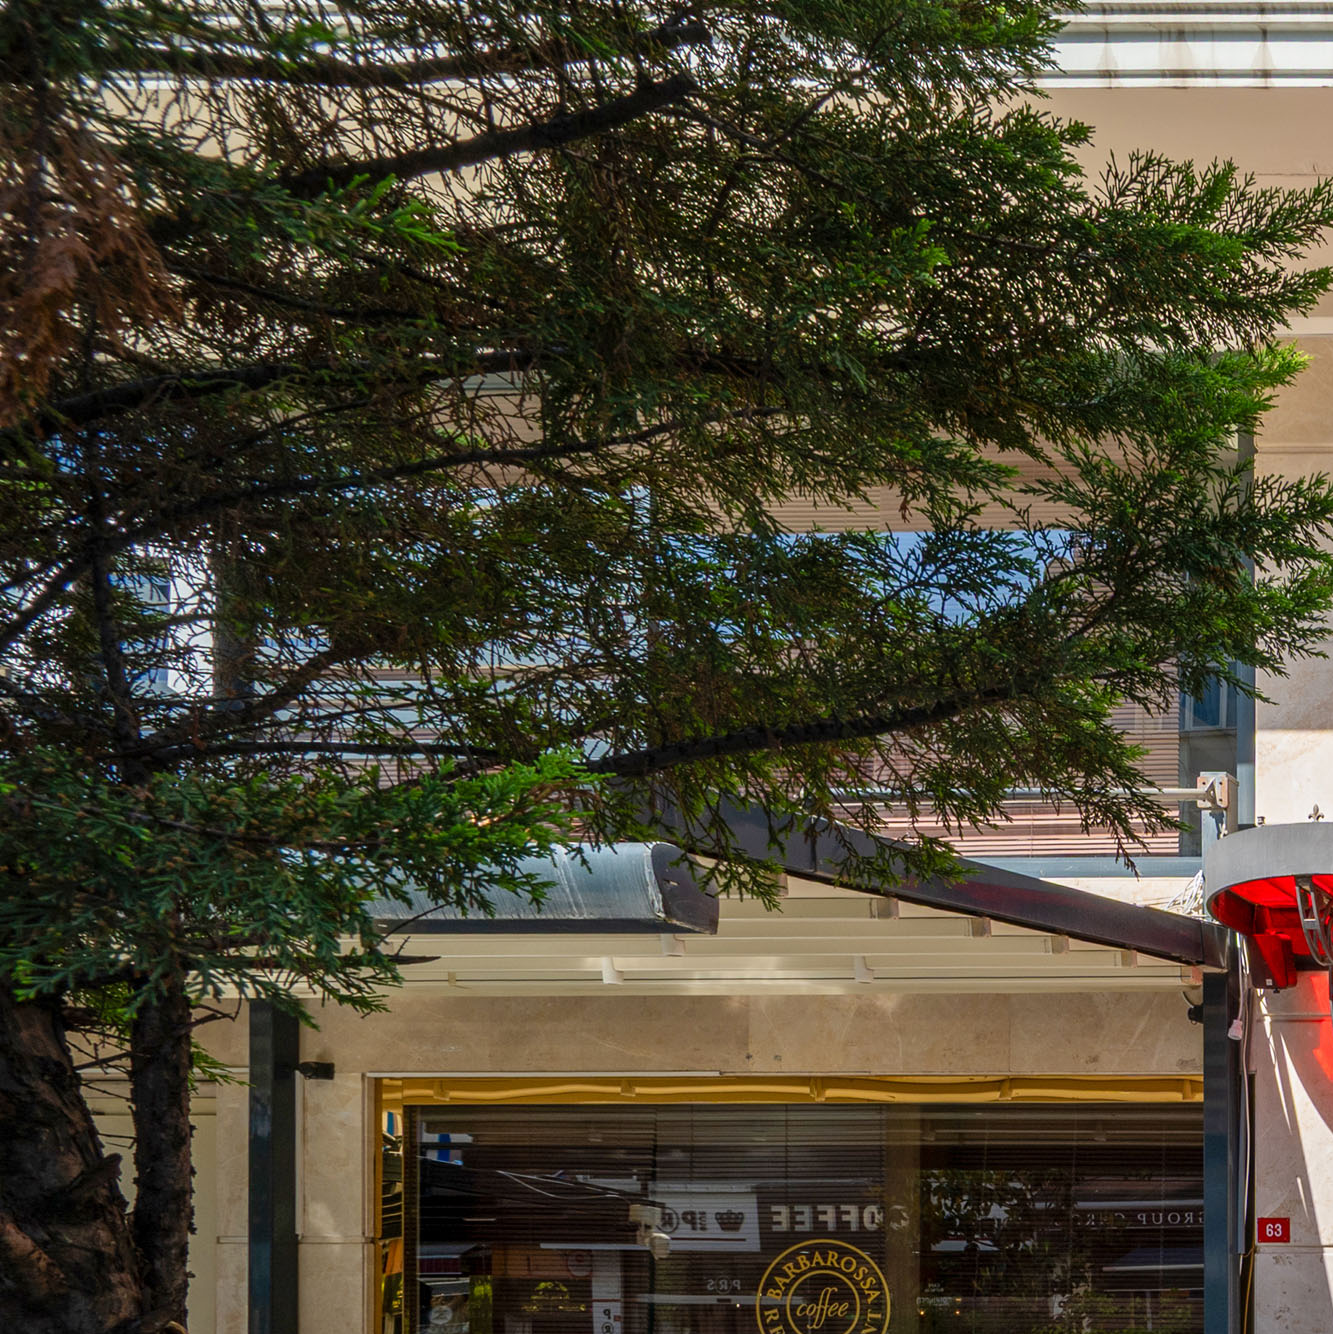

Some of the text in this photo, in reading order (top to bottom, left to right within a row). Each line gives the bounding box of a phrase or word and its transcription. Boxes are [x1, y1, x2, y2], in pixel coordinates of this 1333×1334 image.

[1266, 1223, 1282, 1237] 63
[766, 1250, 882, 1304] BARBAROSSA
[796, 1286, 849, 1329] coffee
